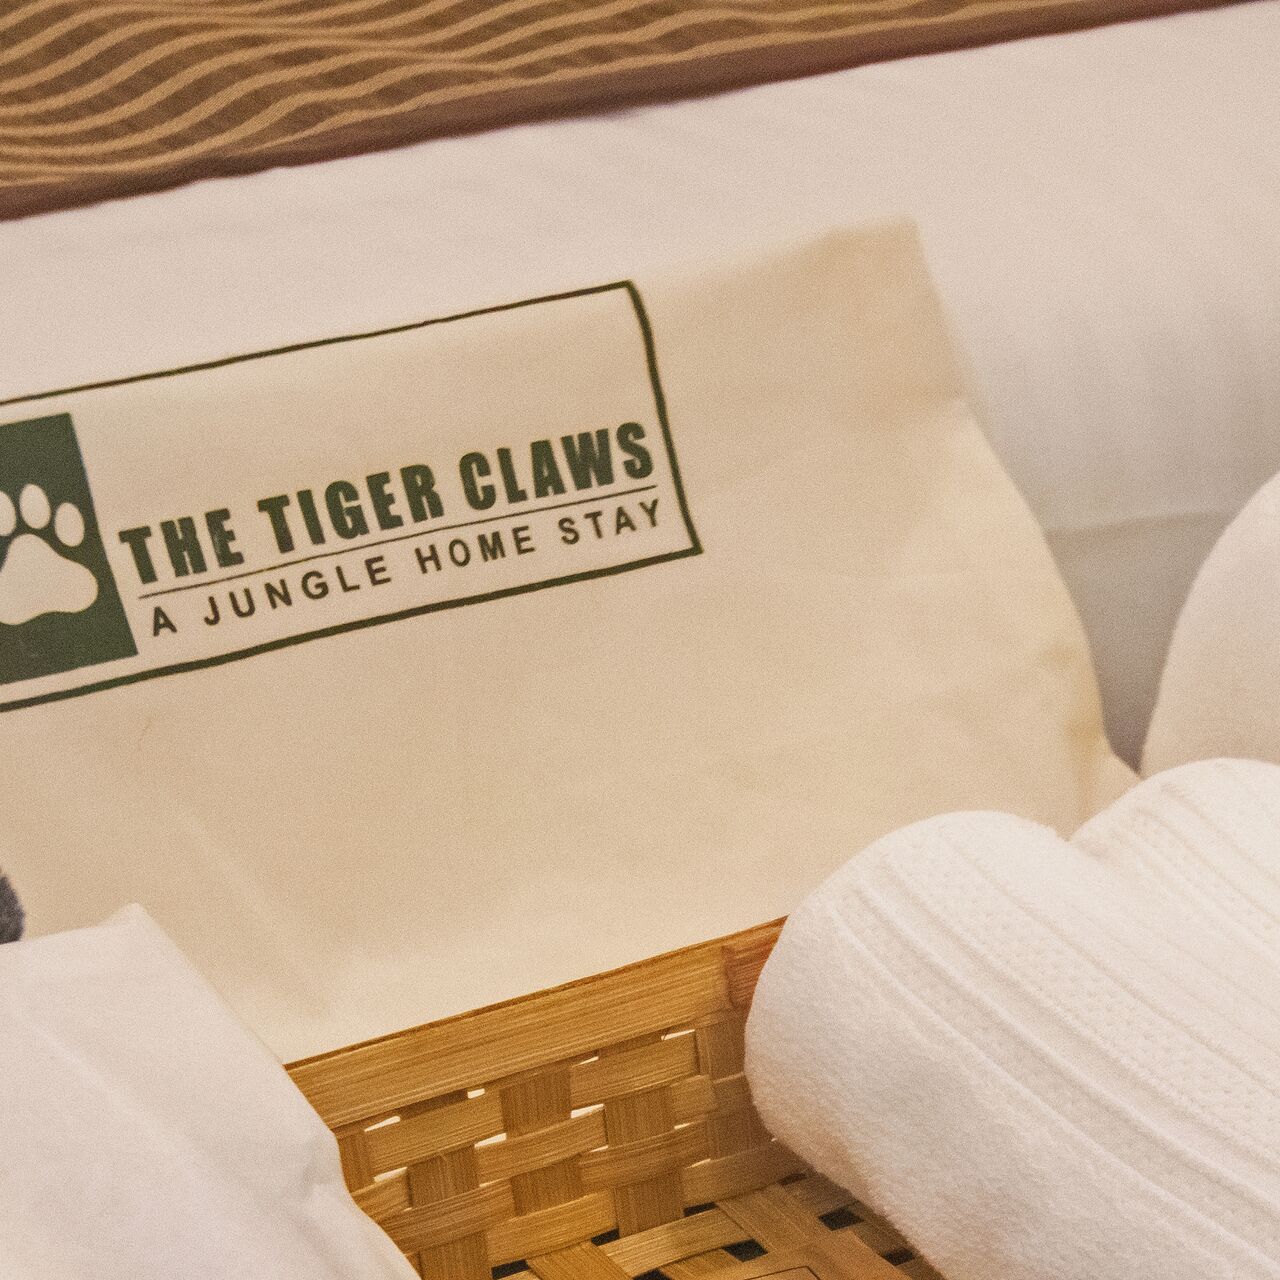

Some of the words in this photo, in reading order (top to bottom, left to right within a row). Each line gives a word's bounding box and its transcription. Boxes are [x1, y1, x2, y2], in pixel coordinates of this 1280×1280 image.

[118, 506, 244, 586] THE
[258, 463, 443, 555] TIGER
[458, 421, 657, 511] CLAWS
[150, 605, 178, 637] A
[203, 555, 394, 627] JUNGLE
[415, 524, 538, 575] HOME
[560, 499, 665, 547] STAY
